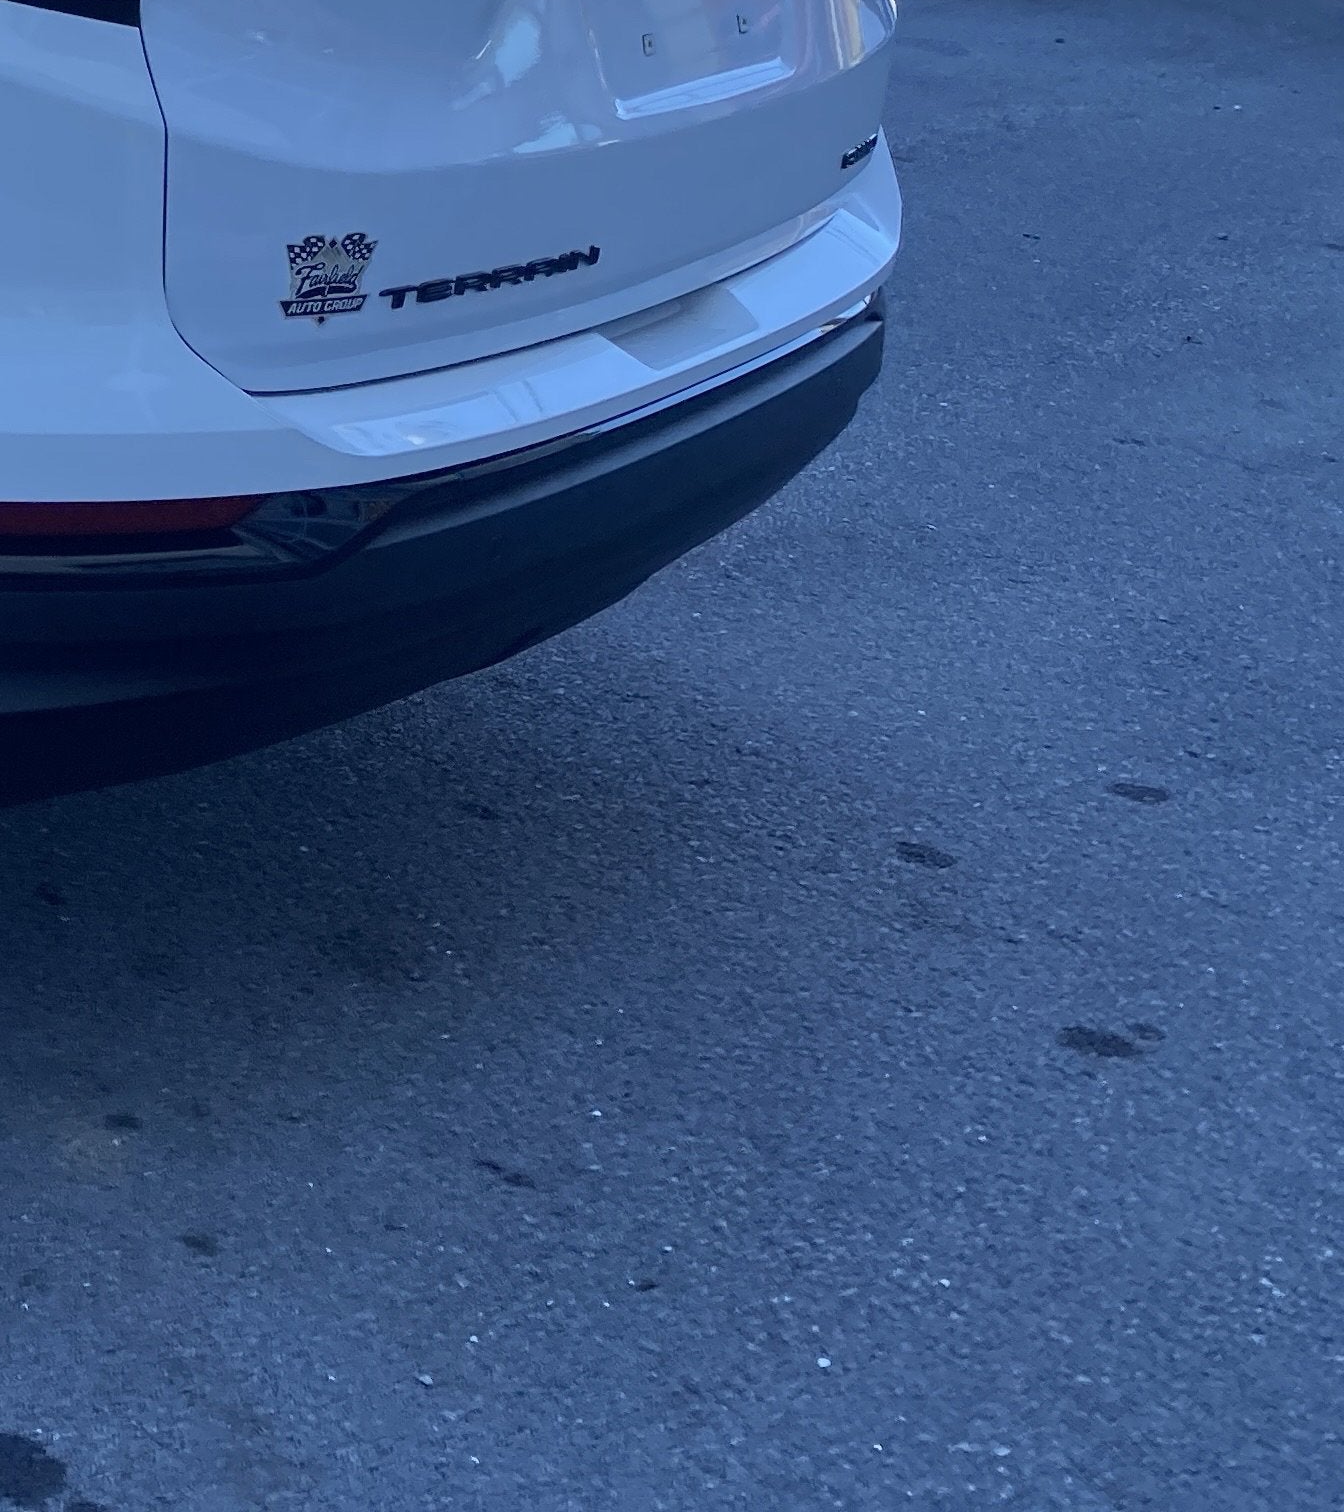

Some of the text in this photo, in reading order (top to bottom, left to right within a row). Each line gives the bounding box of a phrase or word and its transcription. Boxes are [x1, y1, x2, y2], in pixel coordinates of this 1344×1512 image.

[295, 261, 365, 297] Fairfield
[378, 245, 601, 310] TERRAIN
[287, 297, 364, 315] AUTO GROUP
